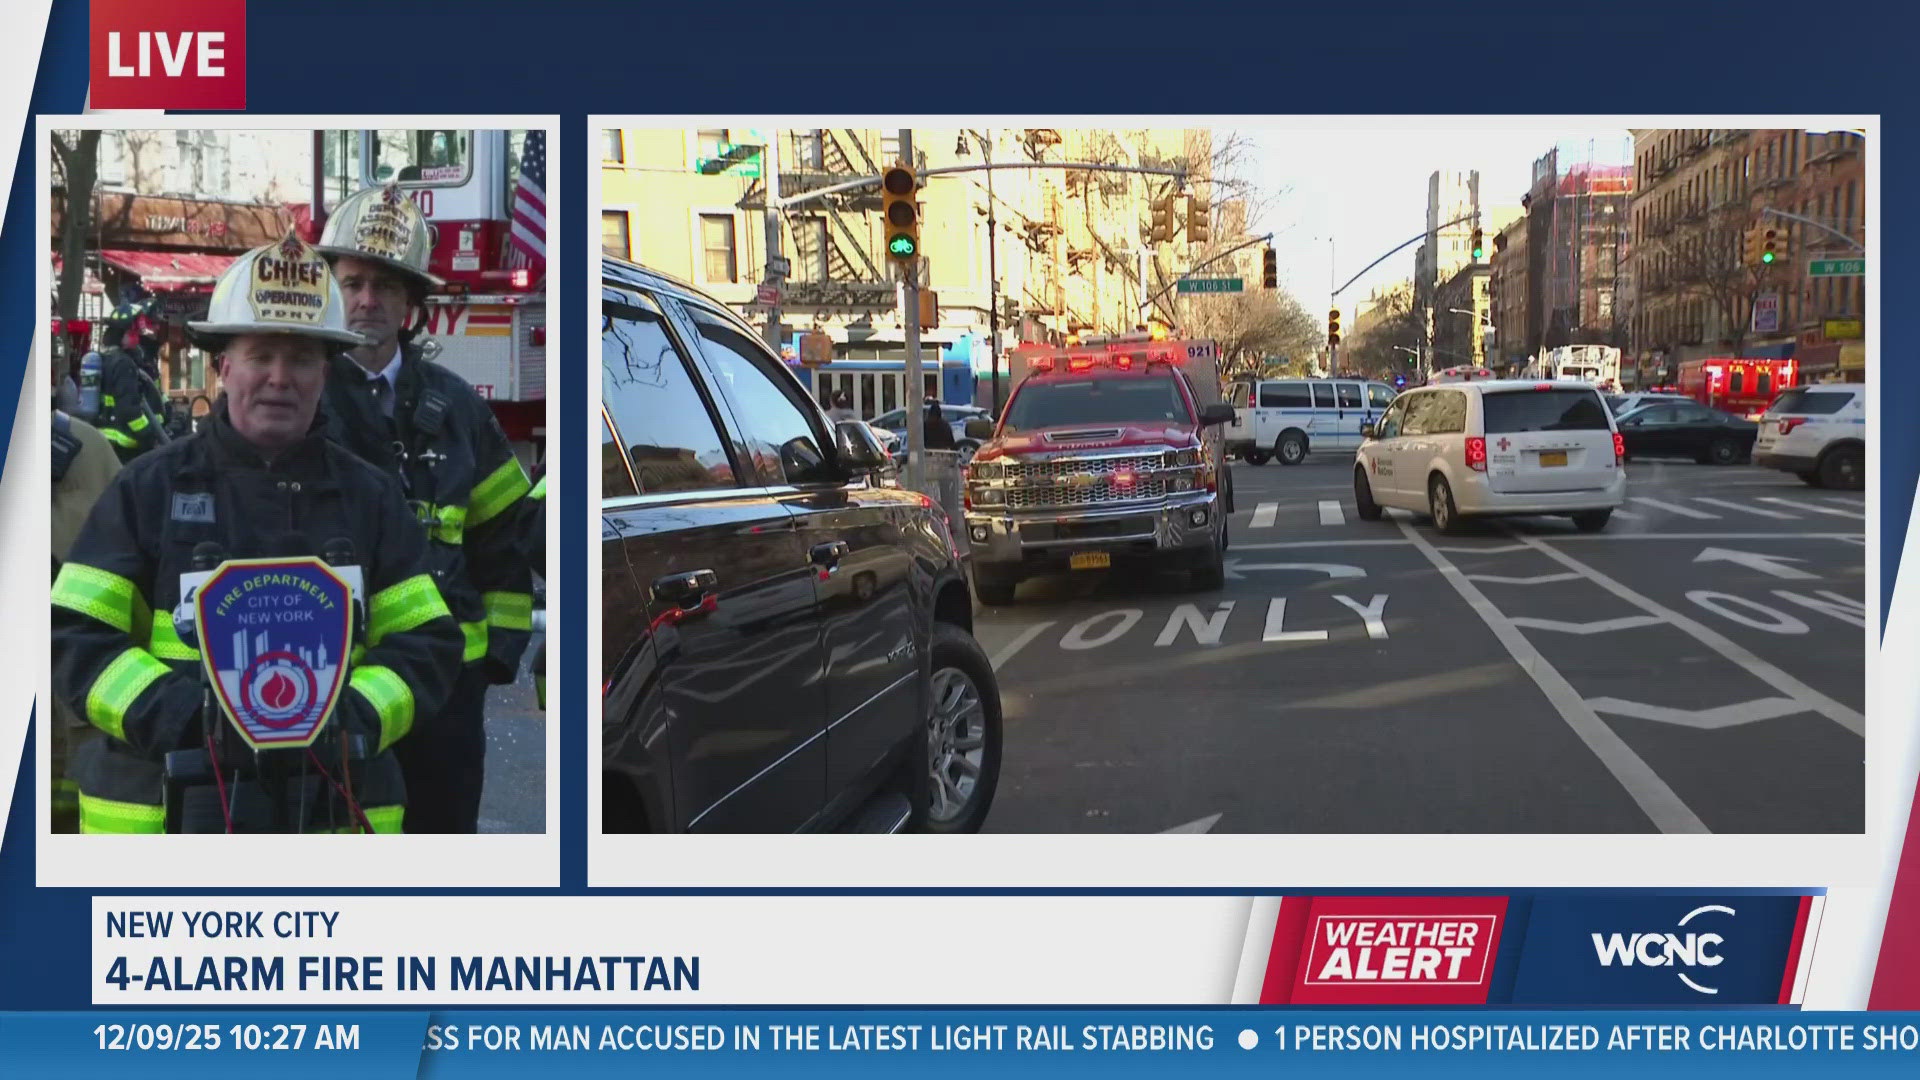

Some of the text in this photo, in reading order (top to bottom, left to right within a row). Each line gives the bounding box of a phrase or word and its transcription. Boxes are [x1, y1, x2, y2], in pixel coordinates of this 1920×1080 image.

[258, 256, 324, 287] CHIEF
[1824, 262, 1861, 273] W 106
[1189, 281, 1198, 291] W
[1202, 281, 1219, 291] 106
[255, 289, 323, 308] OPERATIONS
[1187, 345, 1211, 358] 921
[216, 573, 335, 617] FIRE DEPARTMENT
[248, 594, 303, 609] CITY OF
[238, 610, 314, 625] NEW YORK
[1059, 594, 1390, 651] ONLY
